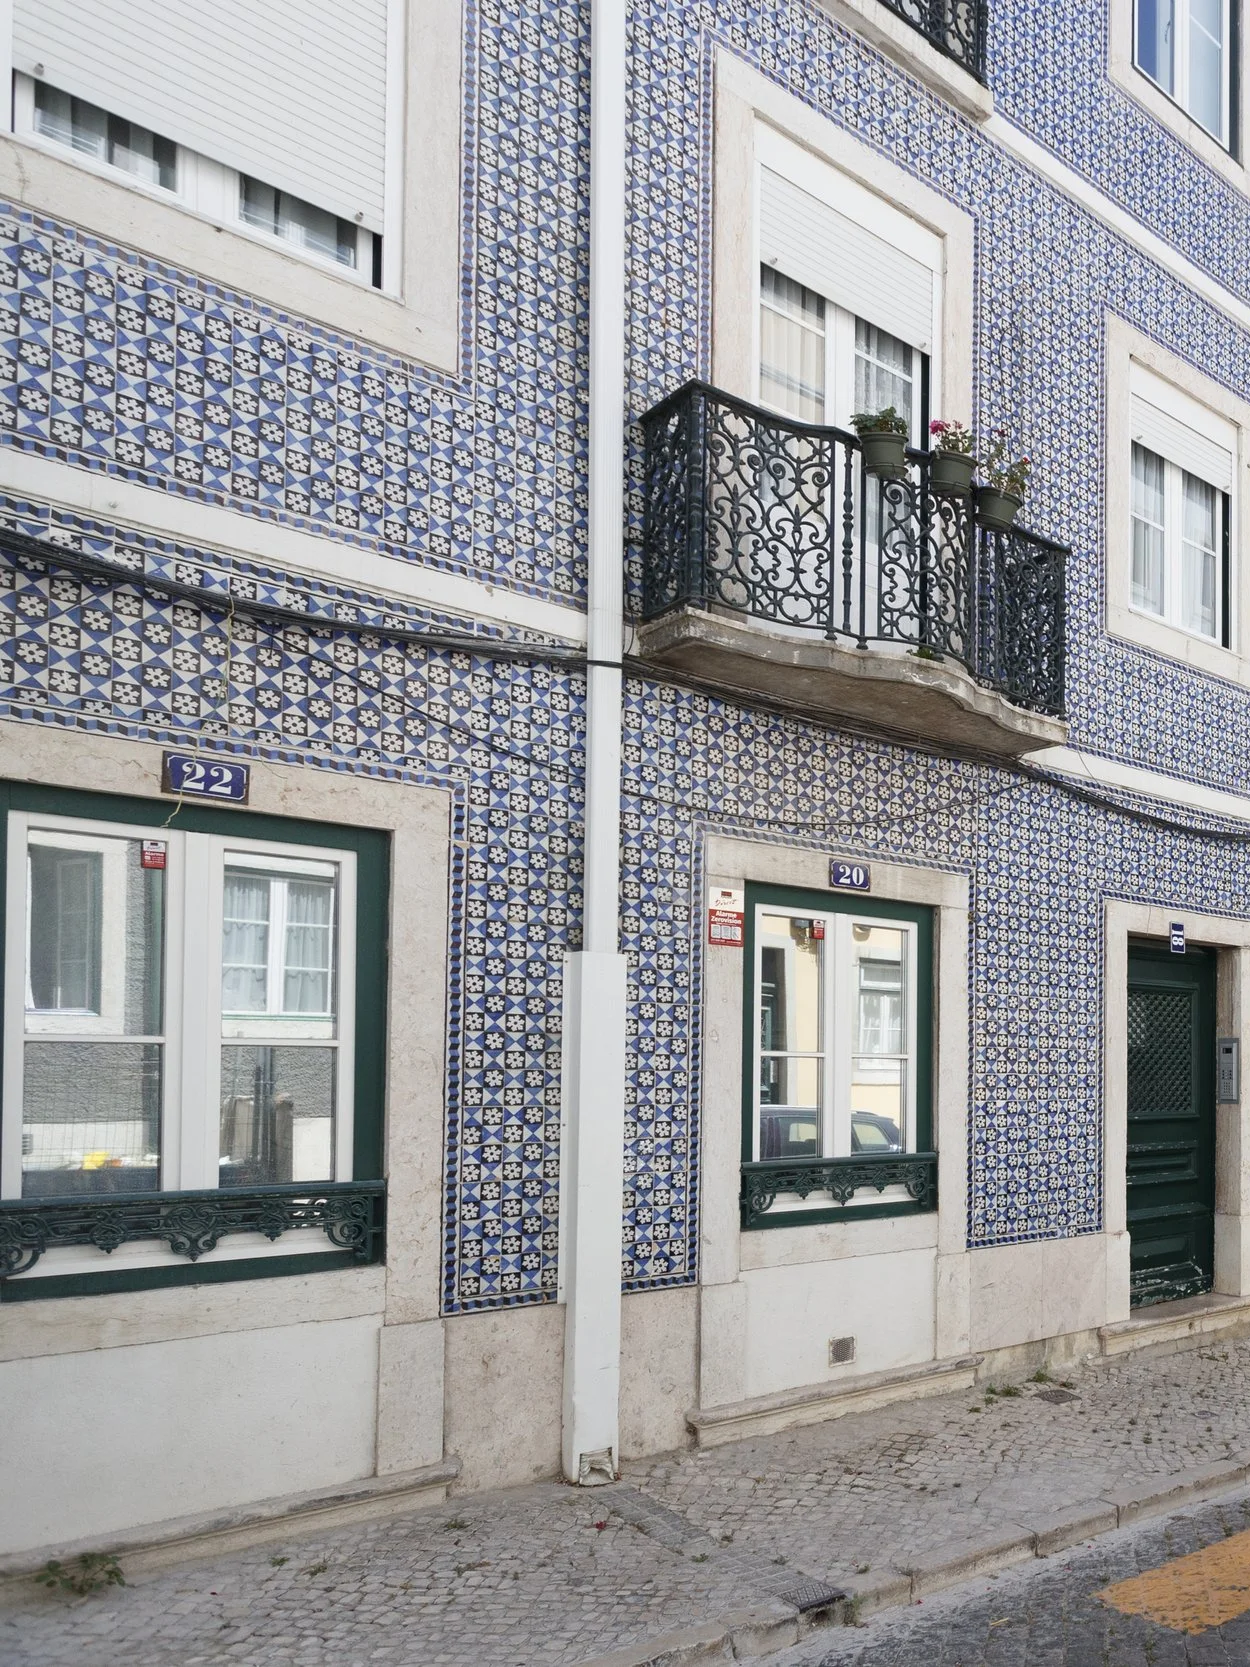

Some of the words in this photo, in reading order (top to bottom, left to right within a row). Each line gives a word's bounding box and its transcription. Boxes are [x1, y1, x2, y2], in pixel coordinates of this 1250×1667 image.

[182, 761, 233, 795] 22
[838, 864, 864, 886] 20
[710, 915, 742, 925] Zerovision
[715, 910, 738, 919] Alarme
[1171, 929, 1184, 946] 18
